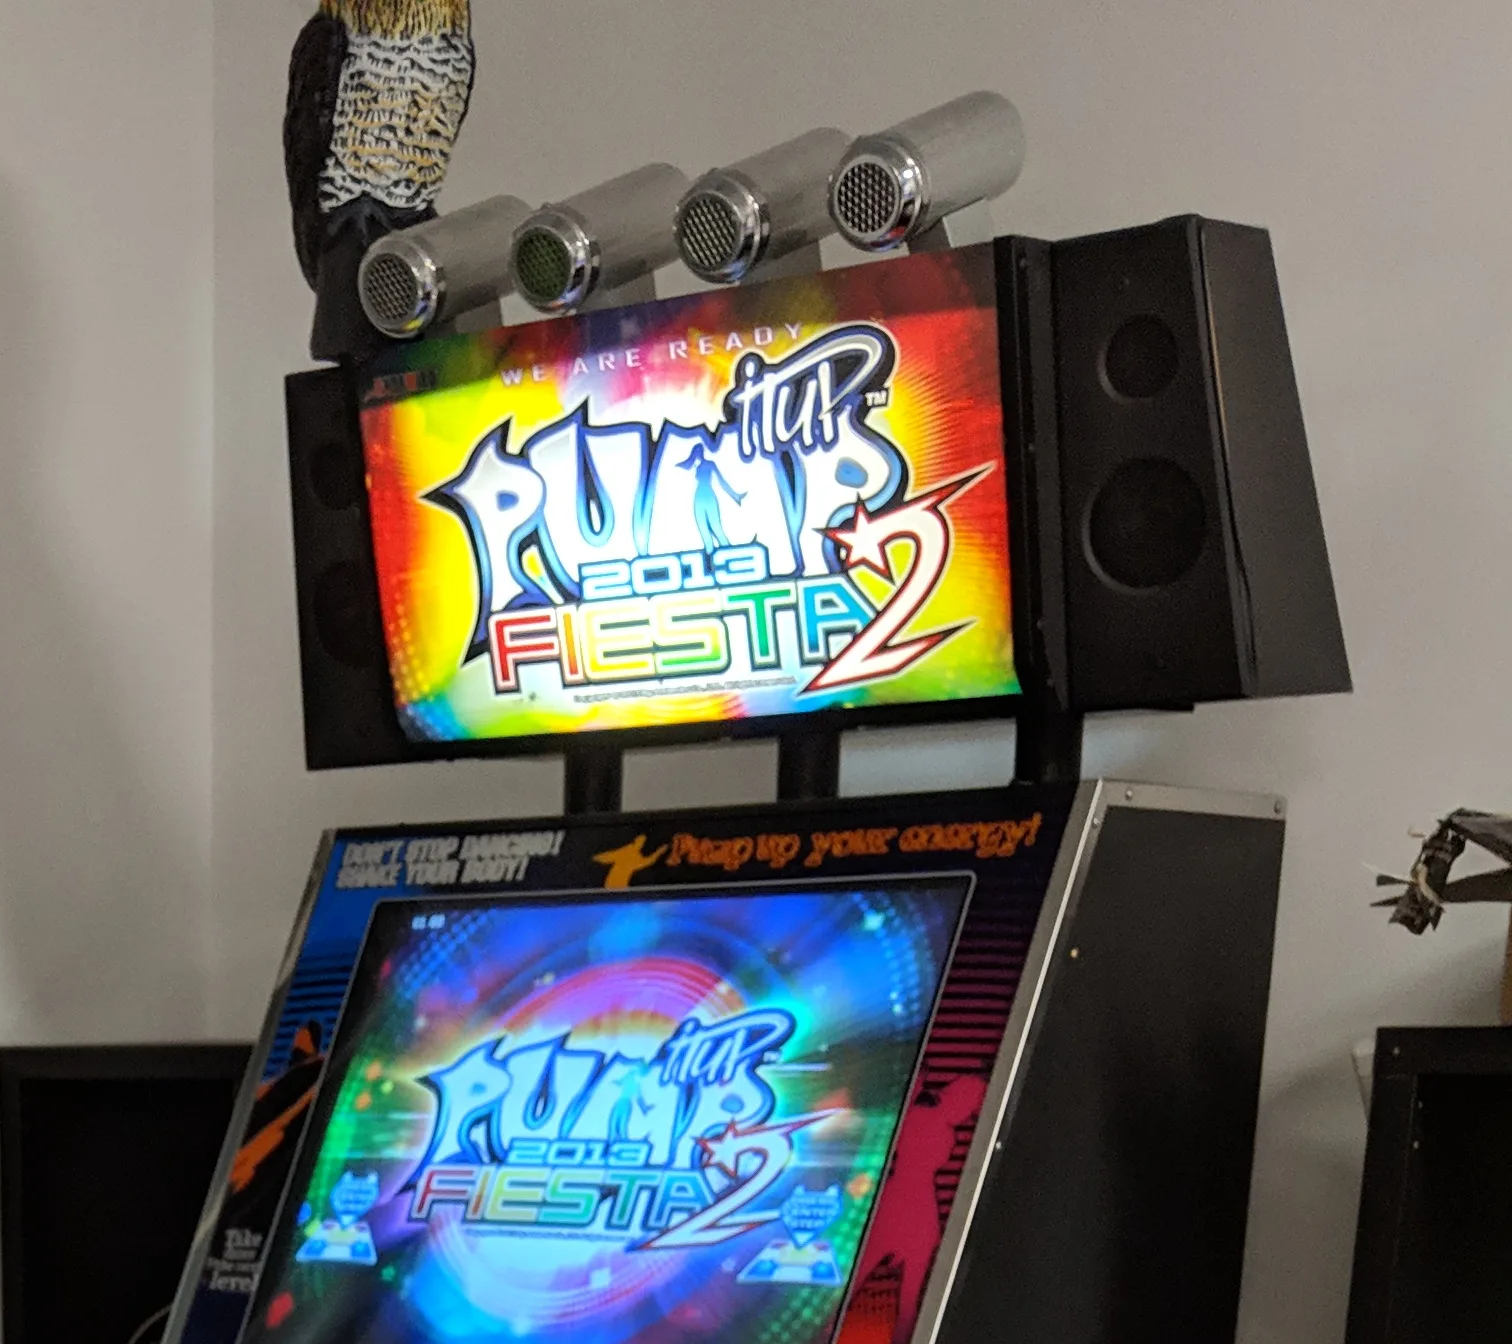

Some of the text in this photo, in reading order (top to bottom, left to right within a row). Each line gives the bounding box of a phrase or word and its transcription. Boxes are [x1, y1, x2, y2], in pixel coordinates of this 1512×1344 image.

[500, 322, 805, 388] WE ARE READY
[578, 549, 774, 602] 2013
[488, 575, 873, 694] FIESTA
[506, 1137, 649, 1165] 2013
[410, 1165, 716, 1230] FIESTA
